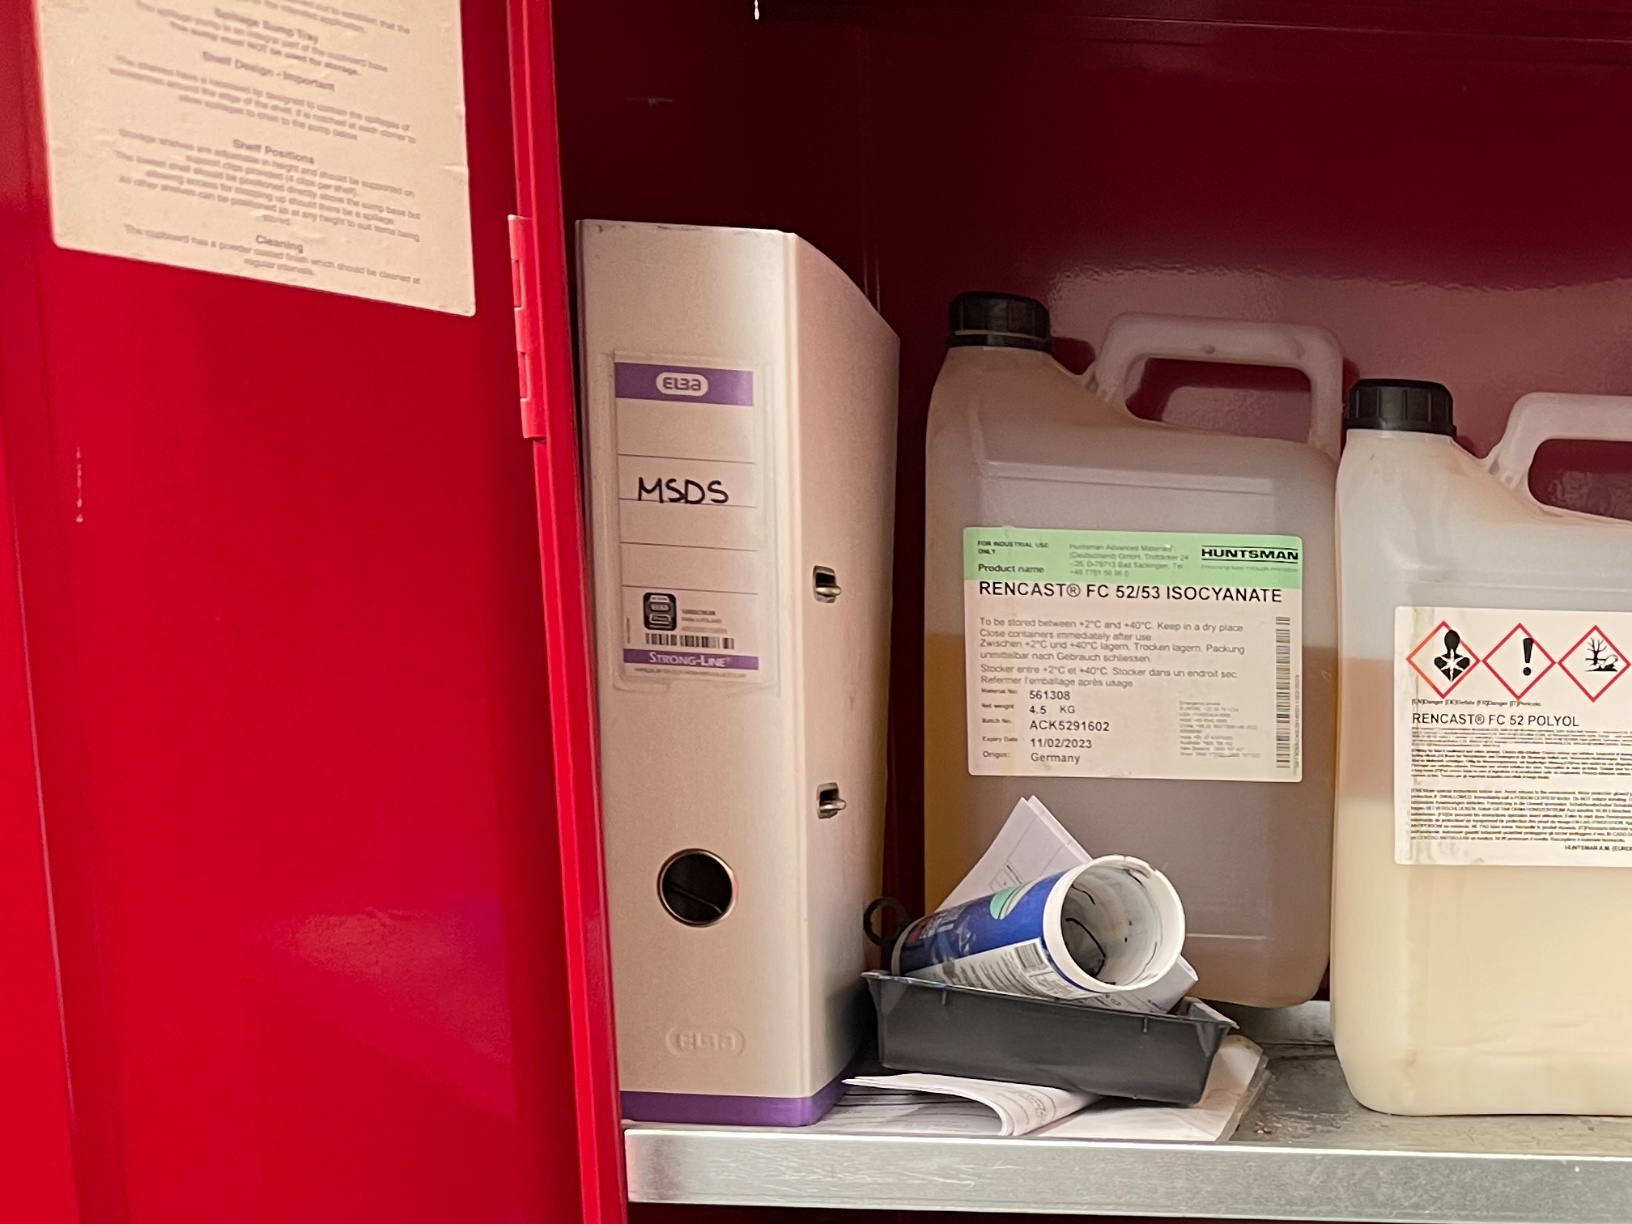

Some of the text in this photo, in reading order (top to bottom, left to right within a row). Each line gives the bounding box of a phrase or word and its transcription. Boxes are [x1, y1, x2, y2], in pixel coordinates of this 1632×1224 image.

[637, 476, 730, 505] MSDS
[1201, 548, 1299, 560] HUNTSMAN
[978, 563, 1045, 574] Product name
[979, 581, 1283, 603] RENCAST® FC 52/53 ISOCYANATE
[980, 617, 992, 626] To
[993, 618, 1006, 627] be
[1008, 618, 1036, 627] stored
[1038, 619, 1077, 628] between
[1104, 621, 1121, 629] and
[1156, 622, 1182, 632] Keep
[1183, 622, 1192, 631] in
[1202, 623, 1217, 633] dry
[1218, 624, 1244, 633] place
[979, 628, 1006, 638] Close
[1112, 632, 1133, 641] after
[1029, 689, 1071, 701] 561308
[1029, 705, 1076, 715] 4.5 KG
[1029, 719, 1110, 732] ACK5291602
[1412, 712, 1580, 727] RENCAST® FC 52 POLYOL
[1030, 738, 1093, 749] 11/02/2023
[1030, 752, 1081, 765] Germany
